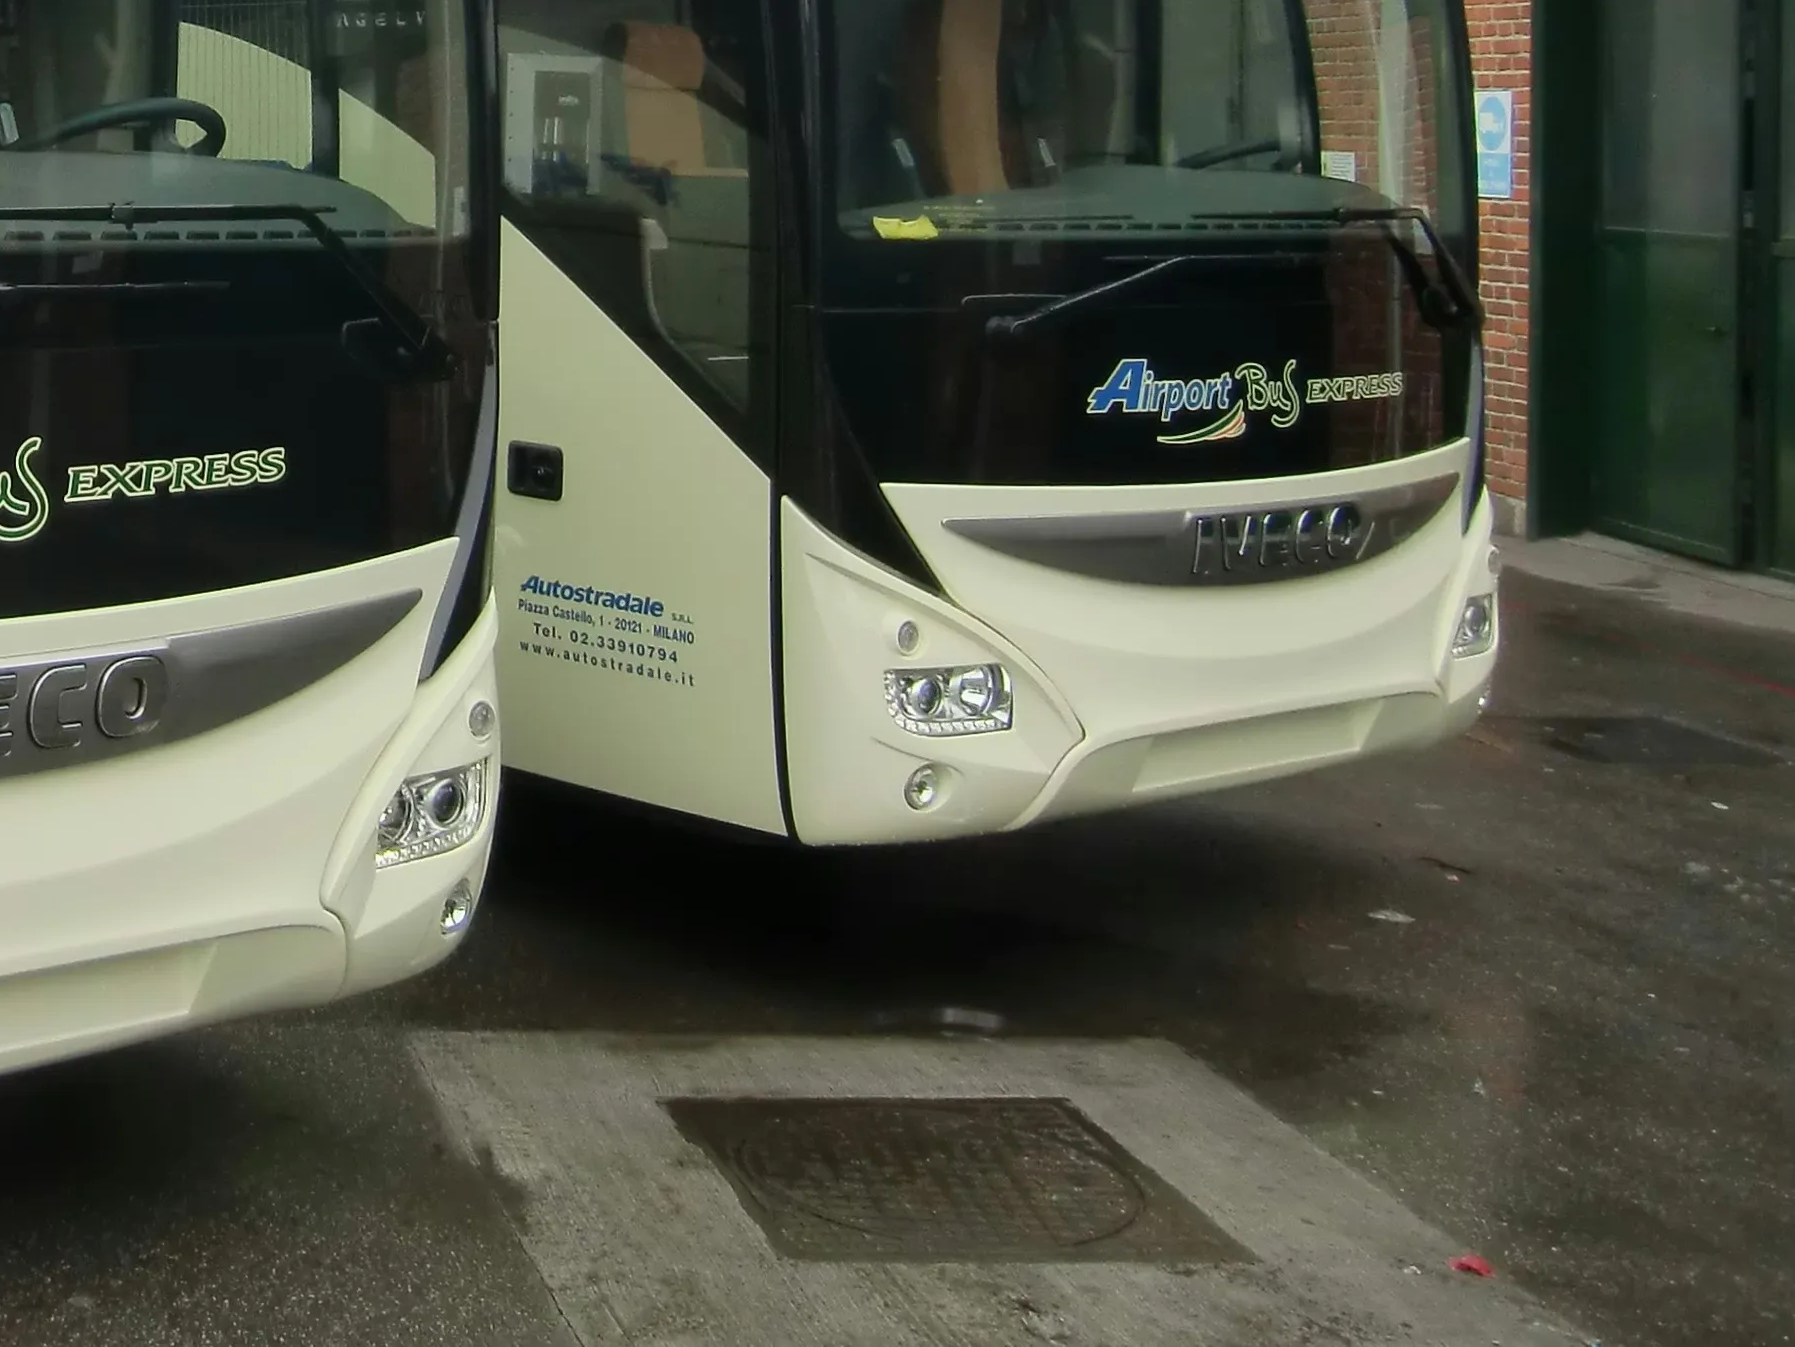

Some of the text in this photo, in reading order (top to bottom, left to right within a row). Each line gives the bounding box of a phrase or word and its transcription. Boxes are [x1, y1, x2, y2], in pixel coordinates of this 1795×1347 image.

[1086, 358, 1404, 428] Airport Bus EXPRESS
[64, 446, 287, 504] EXPRESS
[1191, 506, 1362, 575] IVECO
[520, 575, 664, 617] Autostradale
[518, 599, 549, 616] Piazza
[552, 605, 597, 627] Castello,
[614, 617, 643, 634] 20121
[653, 624, 695, 645] MILANO
[533, 622, 678, 664] Tel. 02.33910794
[519, 640, 695, 687] www.autostradale.it
